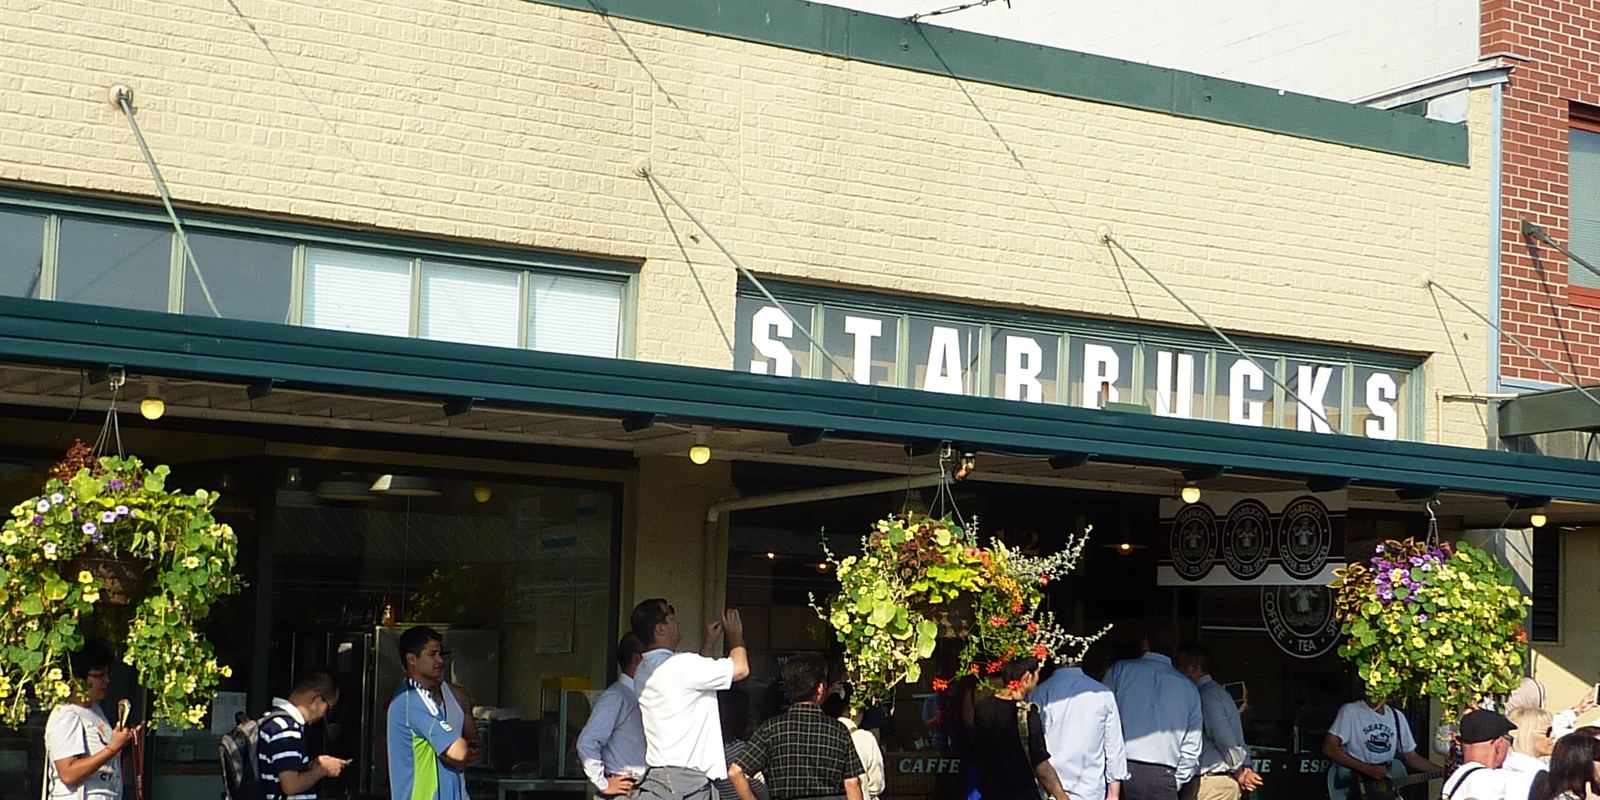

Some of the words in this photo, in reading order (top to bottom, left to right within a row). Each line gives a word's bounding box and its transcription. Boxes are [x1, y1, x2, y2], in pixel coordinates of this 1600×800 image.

[750, 305, 1398, 441] STARBUCKS
[1264, 591, 1287, 640] COFFEE
[1297, 639, 1317, 652] TEA
[898, 758, 961, 774] CAFFE
